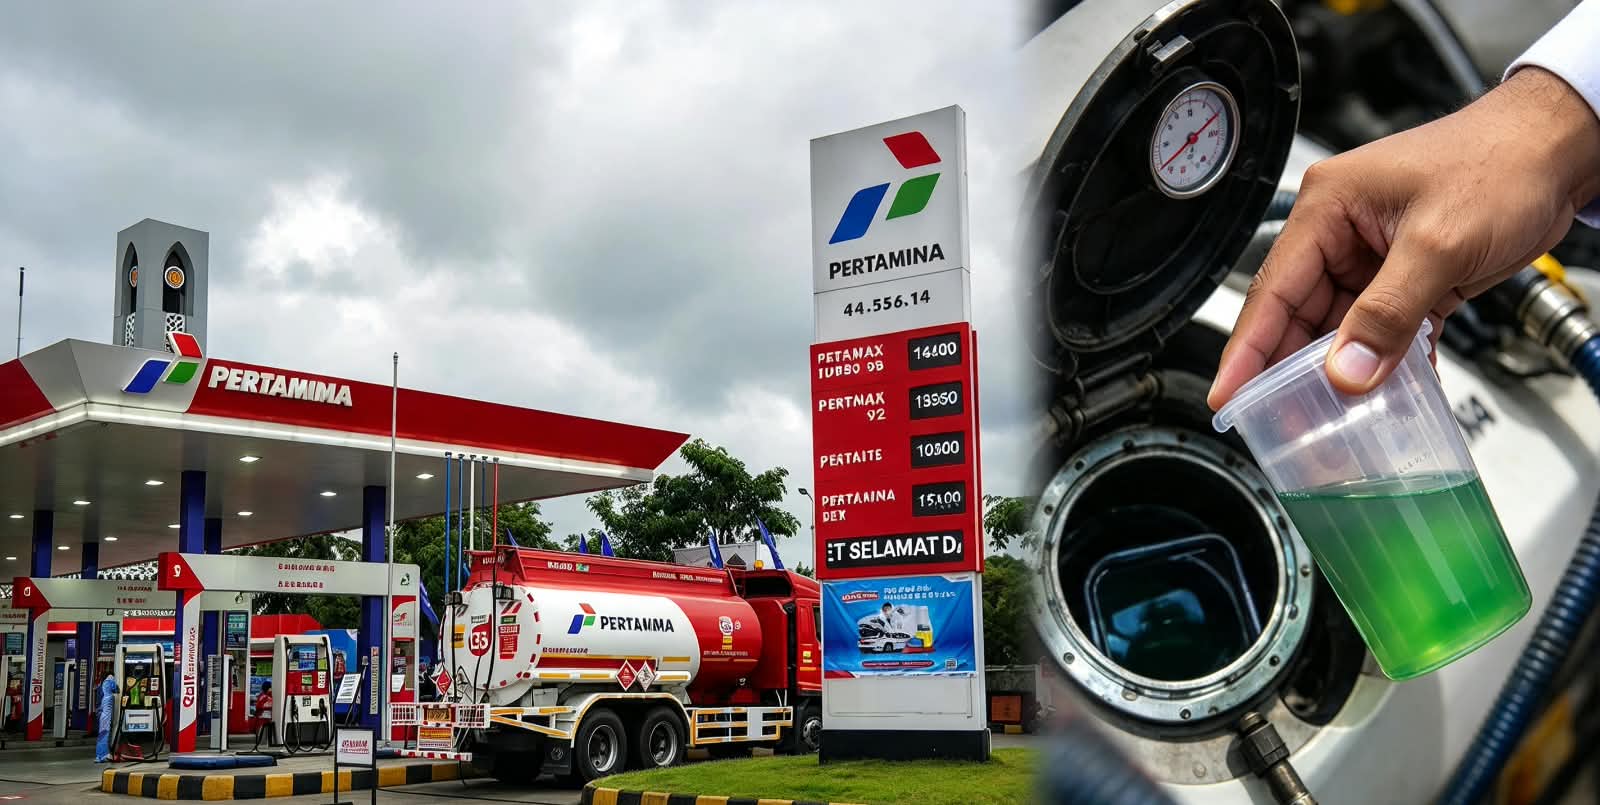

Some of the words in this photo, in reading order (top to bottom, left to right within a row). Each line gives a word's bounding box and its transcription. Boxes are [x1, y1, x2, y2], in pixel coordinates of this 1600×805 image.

[829, 243, 945, 280] PERTAMINA
[843, 289, 931, 317] 44.556.14
[866, 408, 887, 421] 92
[849, 536, 940, 560] SELAMAT
